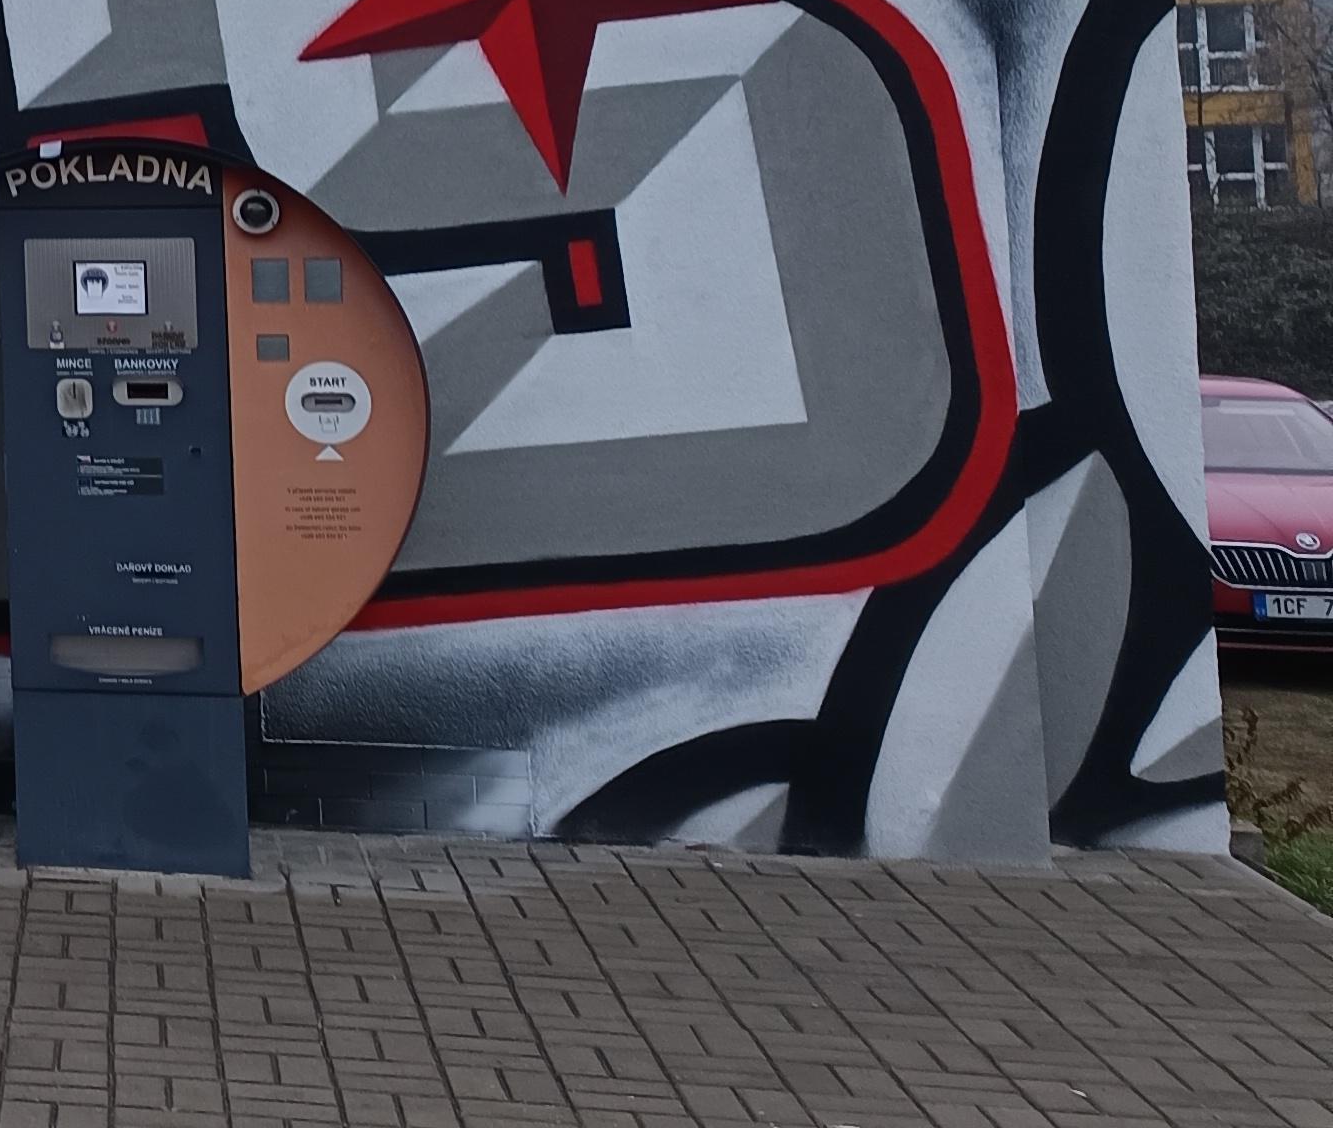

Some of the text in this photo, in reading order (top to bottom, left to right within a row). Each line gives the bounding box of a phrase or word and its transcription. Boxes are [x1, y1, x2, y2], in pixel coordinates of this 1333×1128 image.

[5, 153, 213, 198] POKLADNA
[56, 358, 92, 369] MINCE
[114, 359, 179, 370] BANKOVKY
[309, 377, 347, 387] START
[116, 561, 192, 574] DAŇOVÝ DOKLAD
[1272, 597, 1308, 616] 1CF
[88, 624, 164, 637] VRÁCENÉ PENÍZE
